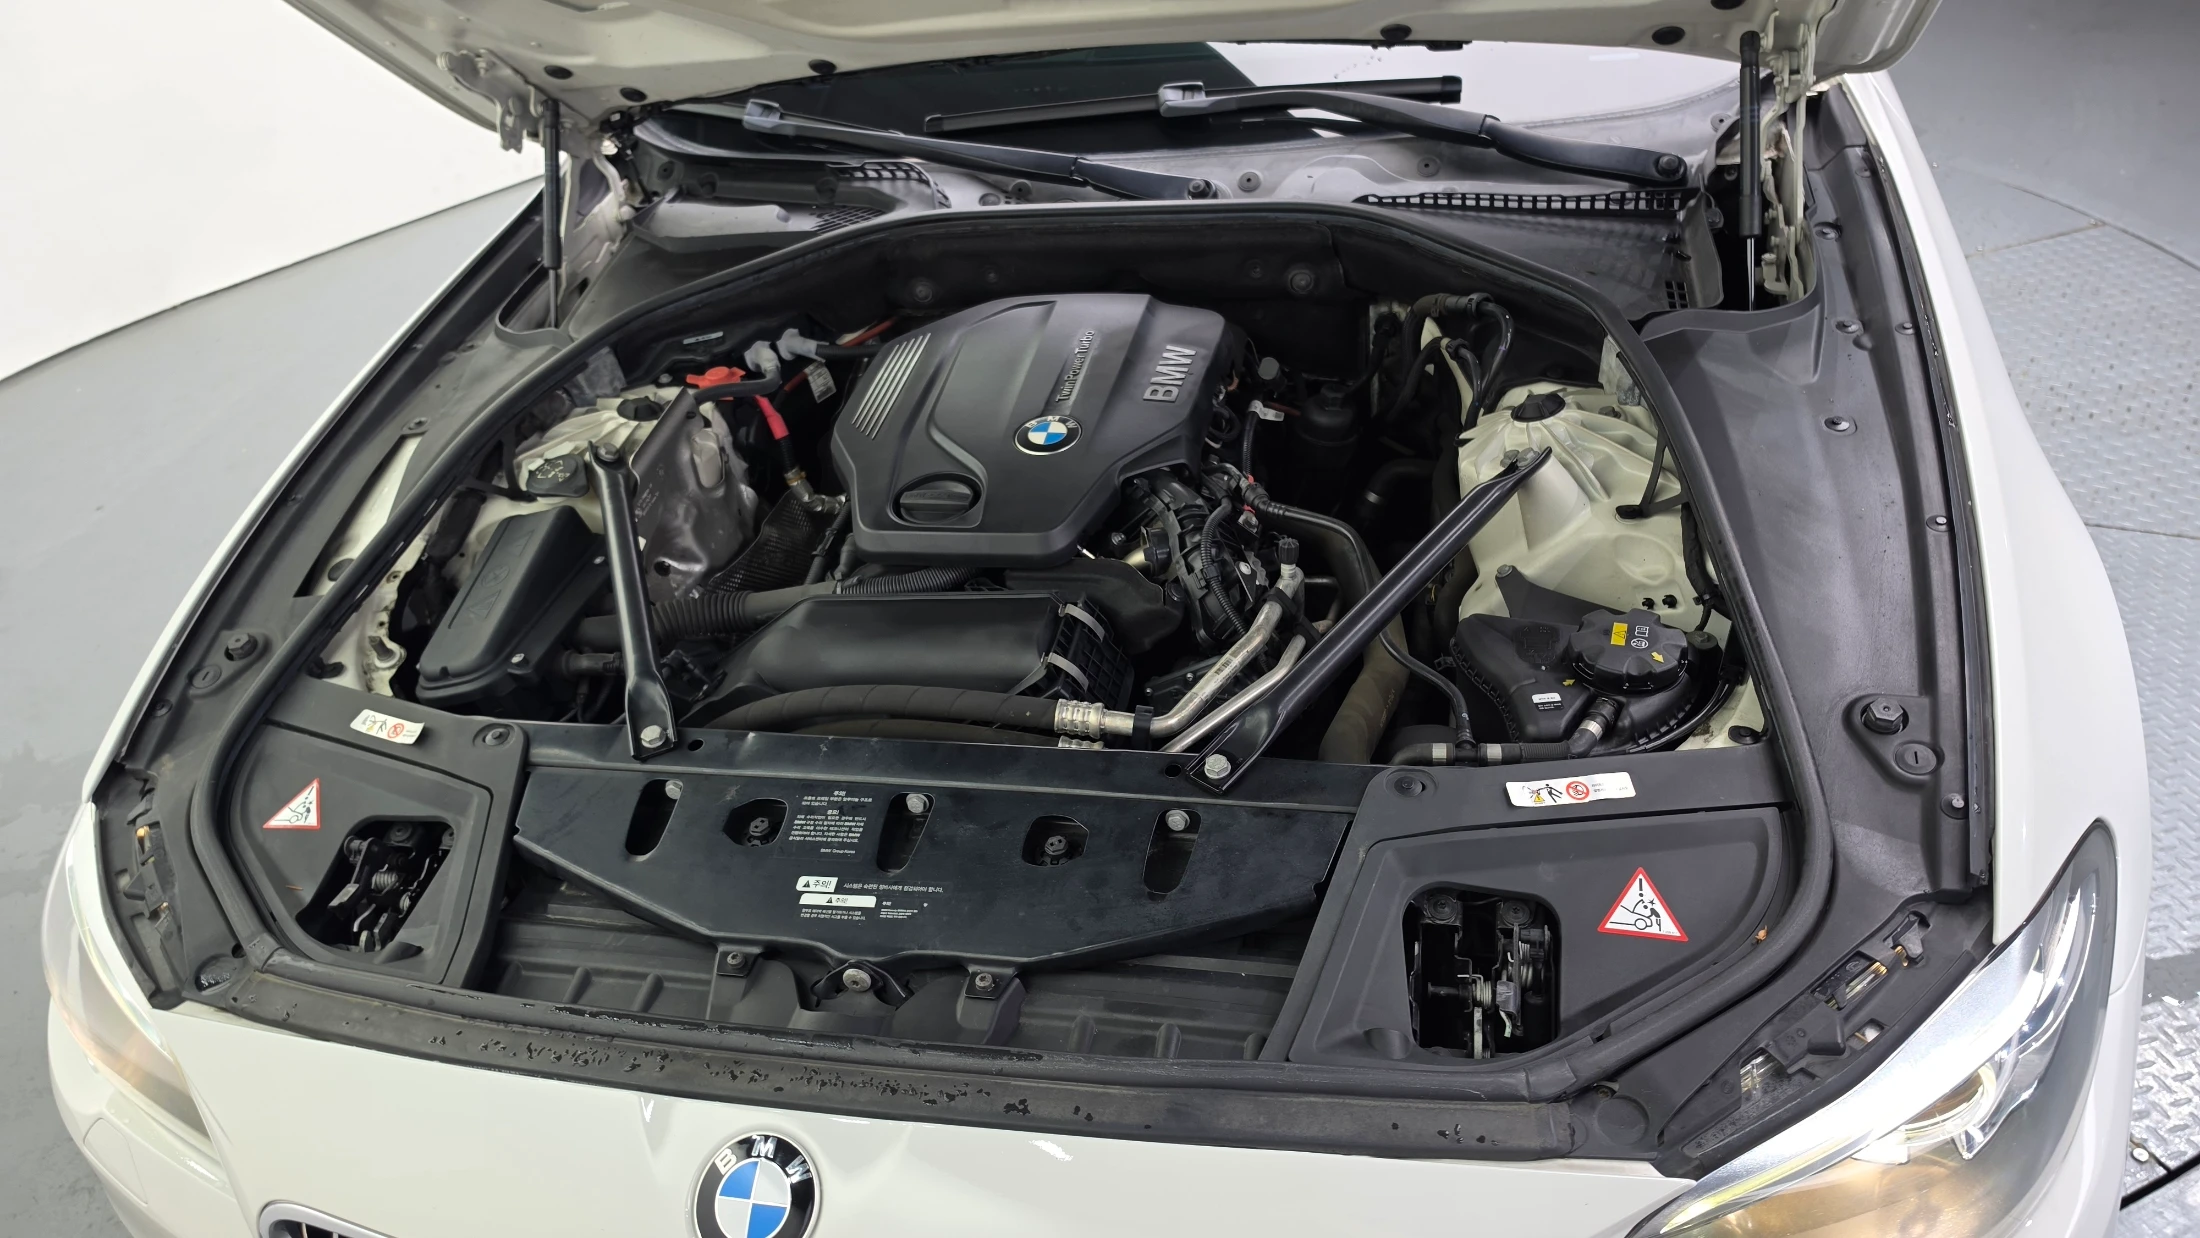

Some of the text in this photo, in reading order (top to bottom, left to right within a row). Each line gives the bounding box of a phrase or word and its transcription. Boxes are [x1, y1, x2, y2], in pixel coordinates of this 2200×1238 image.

[1143, 345, 1197, 403] BMW
[1025, 416, 1077, 428] BMW
[812, 880, 831, 889] 주의!
[714, 1135, 812, 1183] BMW
